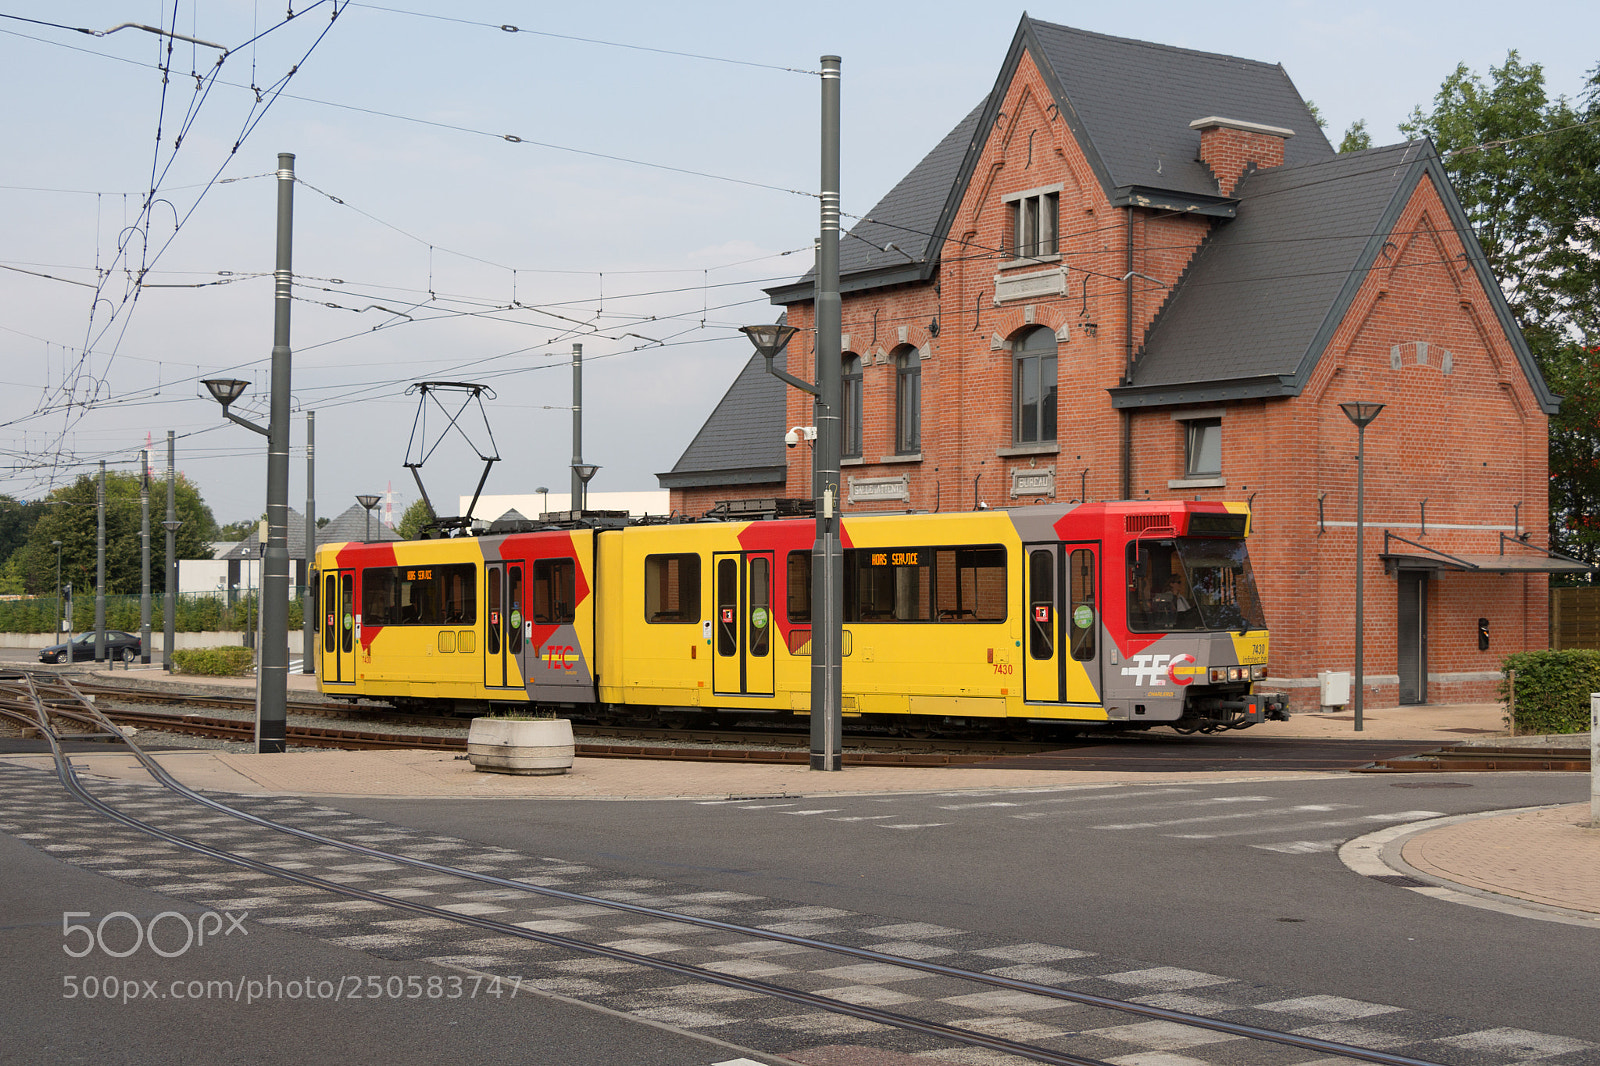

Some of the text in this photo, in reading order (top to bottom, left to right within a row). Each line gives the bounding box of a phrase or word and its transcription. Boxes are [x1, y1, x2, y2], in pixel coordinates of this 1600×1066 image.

[1018, 476, 1048, 488] BUREAU
[871, 552, 919, 566] HORS SERVICE
[1252, 643, 1266, 655] 7430
[547, 645, 574, 670] TEC
[992, 664, 1013, 675] 7430
[1128, 653, 1196, 687] TEC
